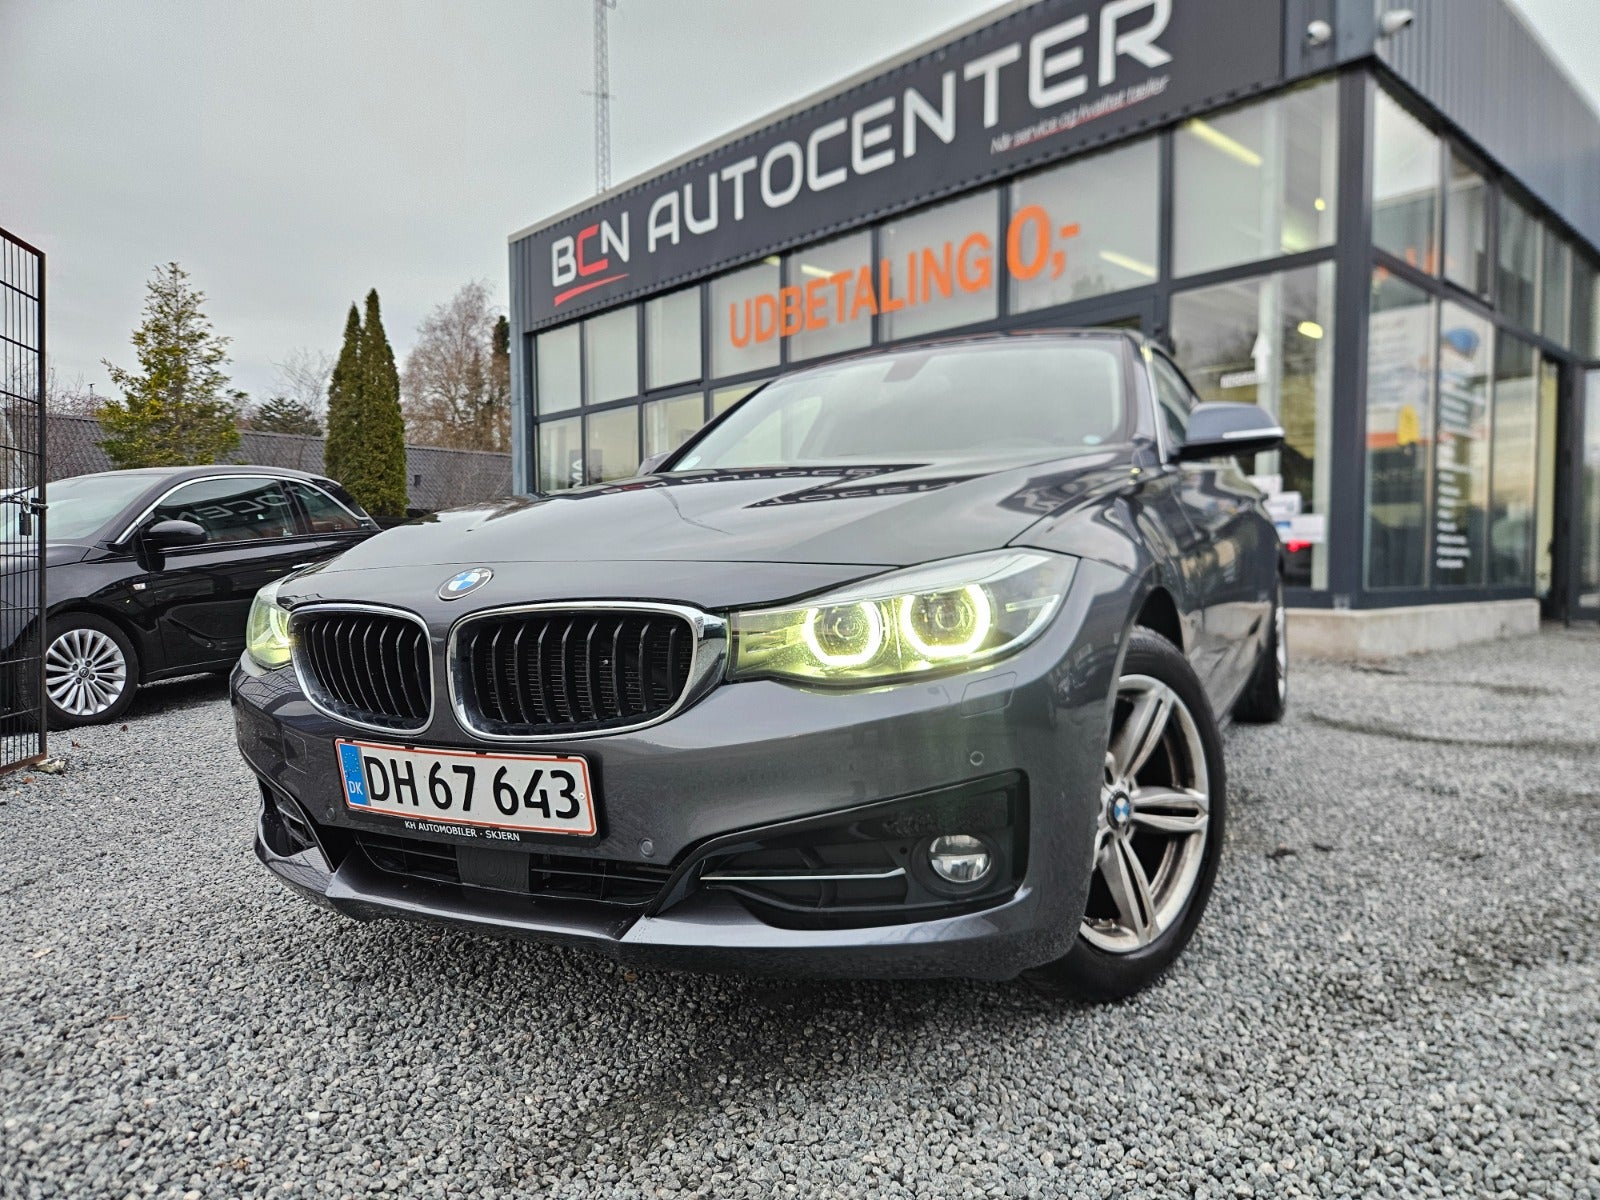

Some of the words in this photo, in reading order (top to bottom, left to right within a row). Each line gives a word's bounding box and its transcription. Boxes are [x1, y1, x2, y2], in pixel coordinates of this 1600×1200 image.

[552, 211, 630, 287] BCN
[647, 0, 1173, 253] AUTOCENTER
[730, 232, 992, 348] UDBETALING
[348, 780, 364, 796] DK
[364, 755, 419, 807] DH
[428, 761, 476, 812] 67
[493, 765, 581, 819] 643
[405, 820, 417, 830] KH
[418, 822, 478, 838] AUTOMOBILER
[485, 829, 520, 842] SKJERN
